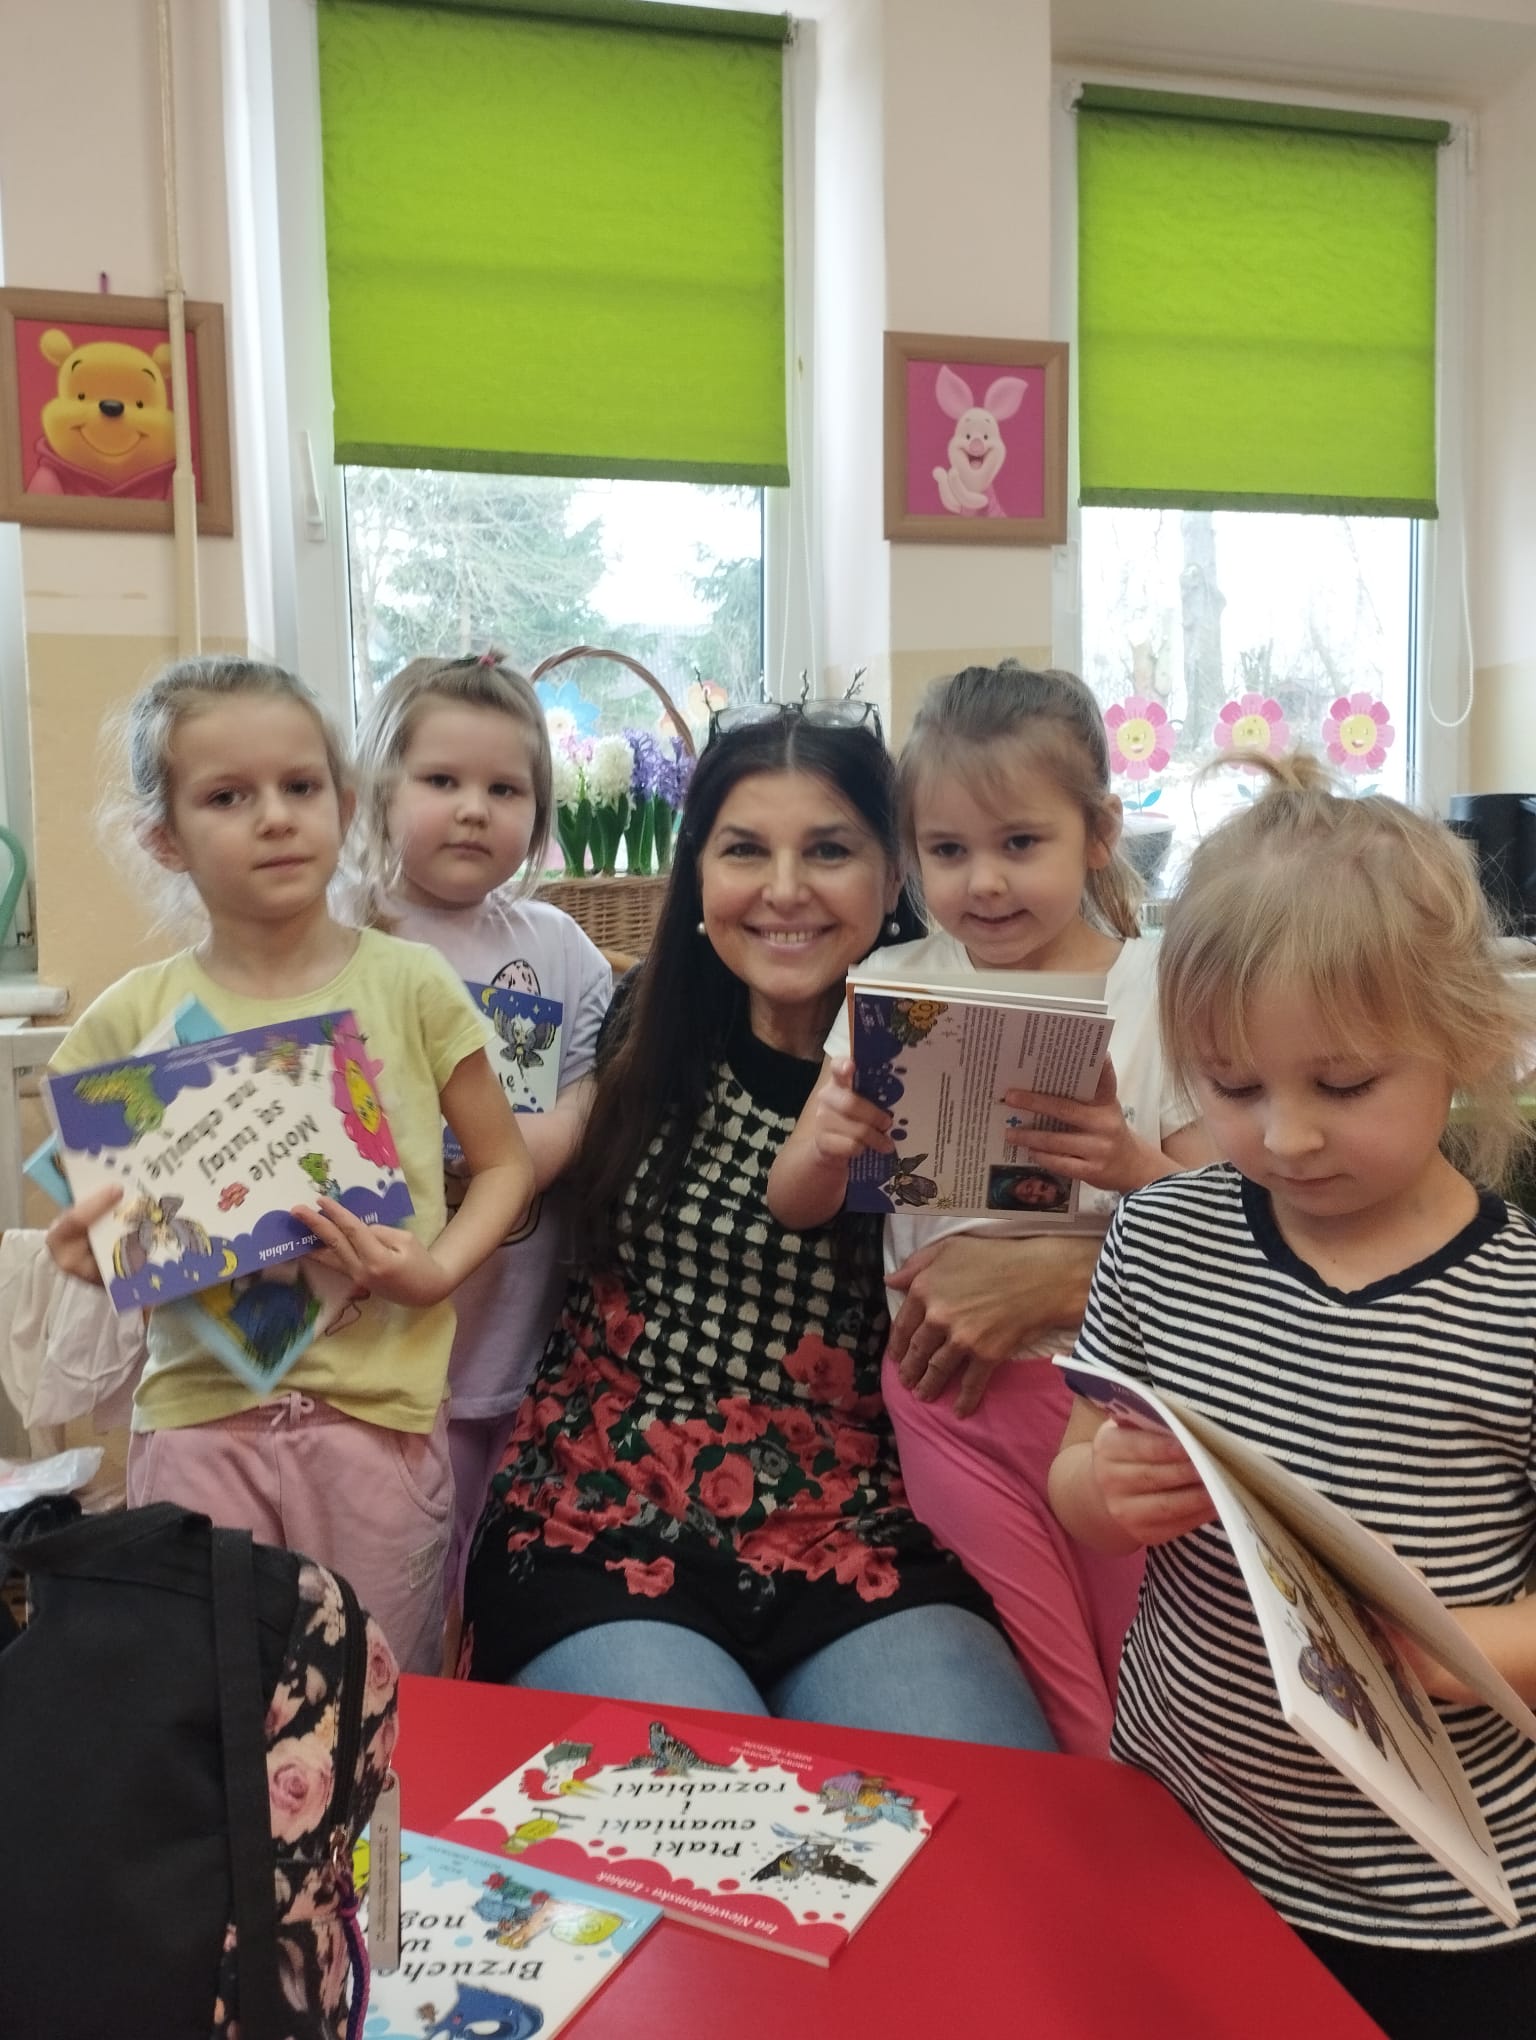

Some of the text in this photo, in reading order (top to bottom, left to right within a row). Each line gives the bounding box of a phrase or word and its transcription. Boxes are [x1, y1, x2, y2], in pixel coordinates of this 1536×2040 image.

[225, 1080, 257, 1110] na
[199, 1126, 258, 1185] tutaj
[249, 1114, 320, 1181] Motyle
[612, 1782, 787, 1798] rozrabiaki
[681, 1800, 691, 1815] i
[598, 1818, 756, 1834] cwaniaki
[652, 1840, 742, 1858] Ptaki
